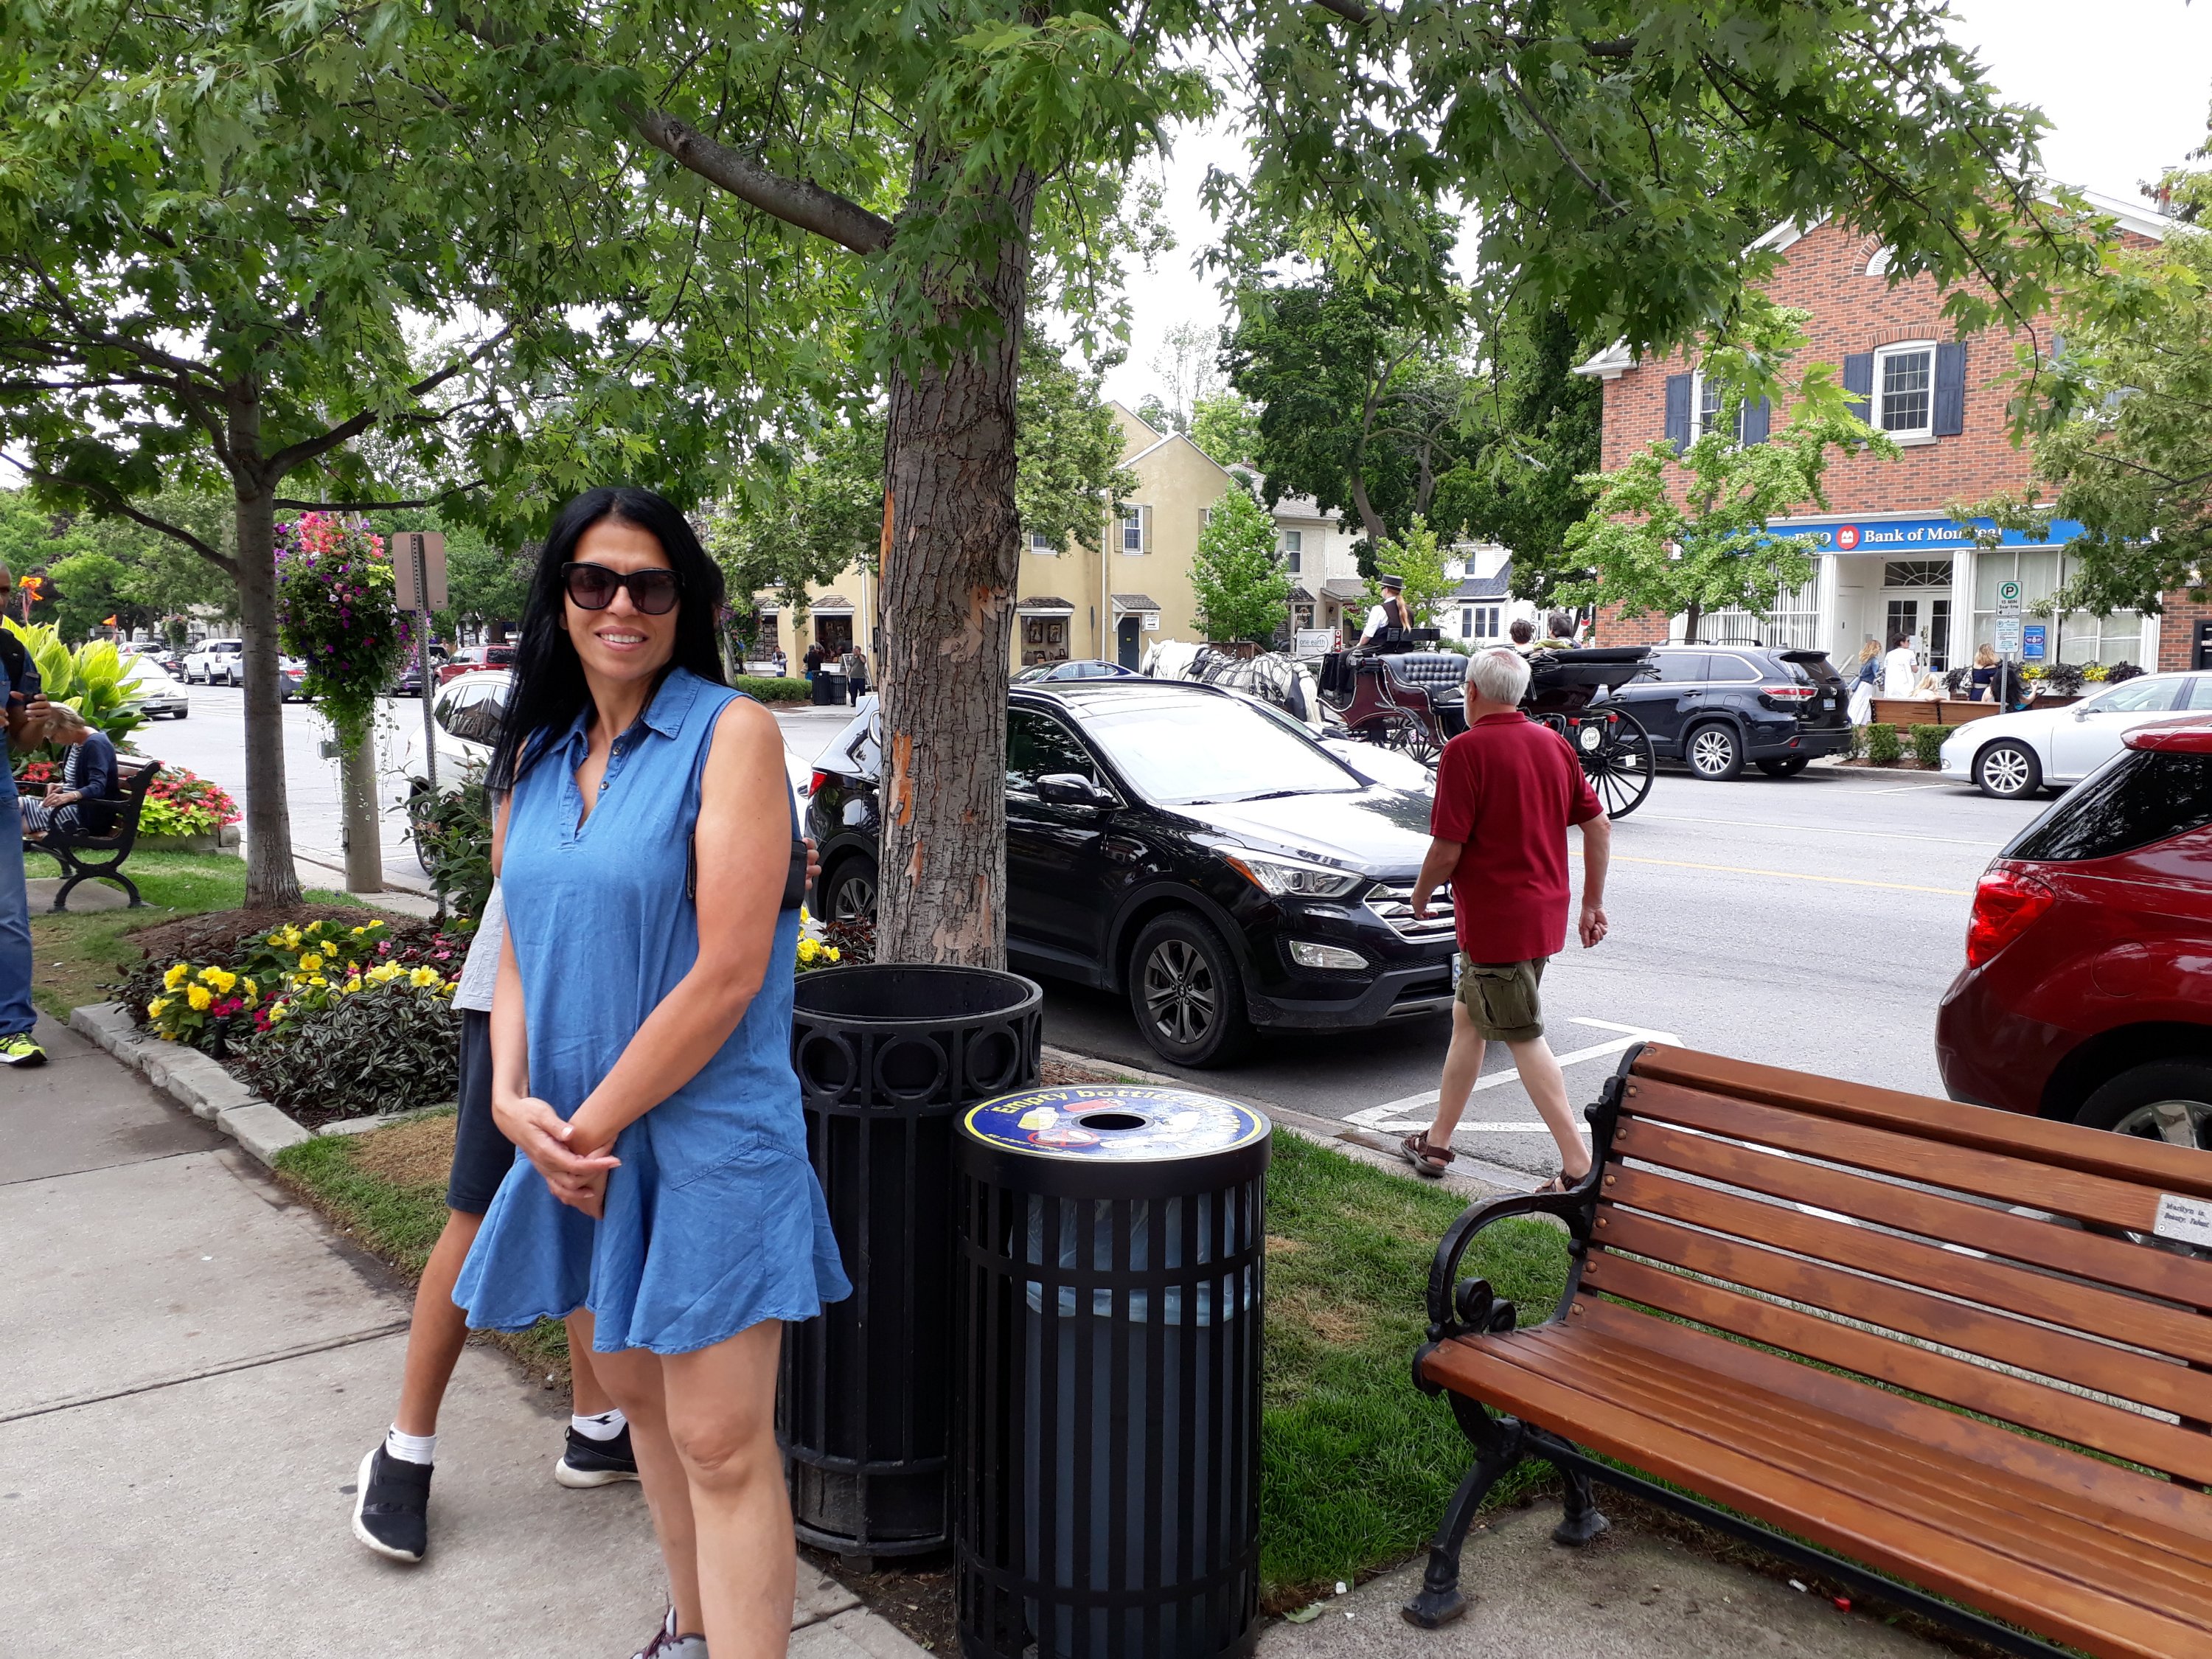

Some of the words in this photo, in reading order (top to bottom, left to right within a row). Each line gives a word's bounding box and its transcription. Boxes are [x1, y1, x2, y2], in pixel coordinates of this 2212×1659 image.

[1864, 529, 1905, 543] Bank
[1907, 527, 1925, 541] of
[2006, 586, 2014, 596] P
[1310, 638, 1325, 646] earth
[991, 1091, 1068, 1114] Empty
[1075, 1089, 1182, 1102] bottles
[2165, 1202, 2194, 1214] Marilyn
